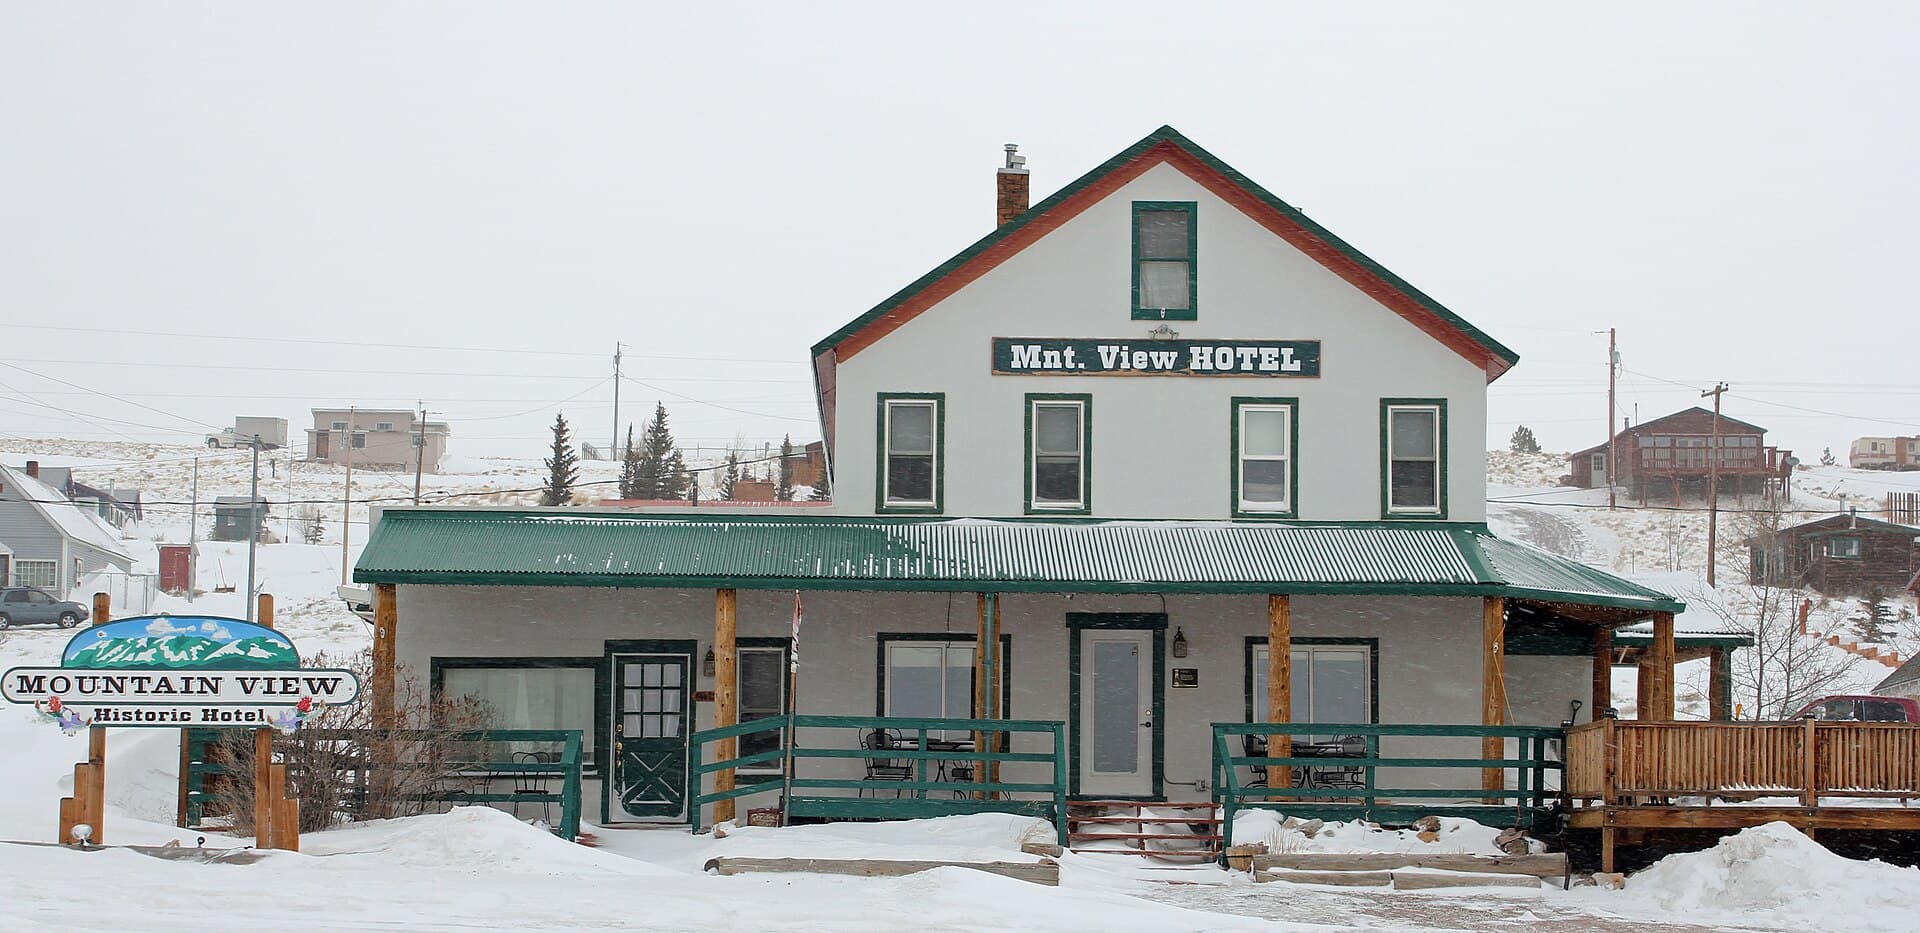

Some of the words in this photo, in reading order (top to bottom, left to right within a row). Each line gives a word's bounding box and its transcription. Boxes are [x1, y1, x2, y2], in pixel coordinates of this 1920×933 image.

[1010, 345, 1085, 369] Mnt.
[1097, 345, 1178, 370] View
[1189, 346, 1301, 371] HOTEL
[16, 675, 223, 696] MOUNTAIN
[236, 676, 343, 697] VIEW
[93, 708, 192, 723] Historic
[201, 708, 265, 723] Hotel
